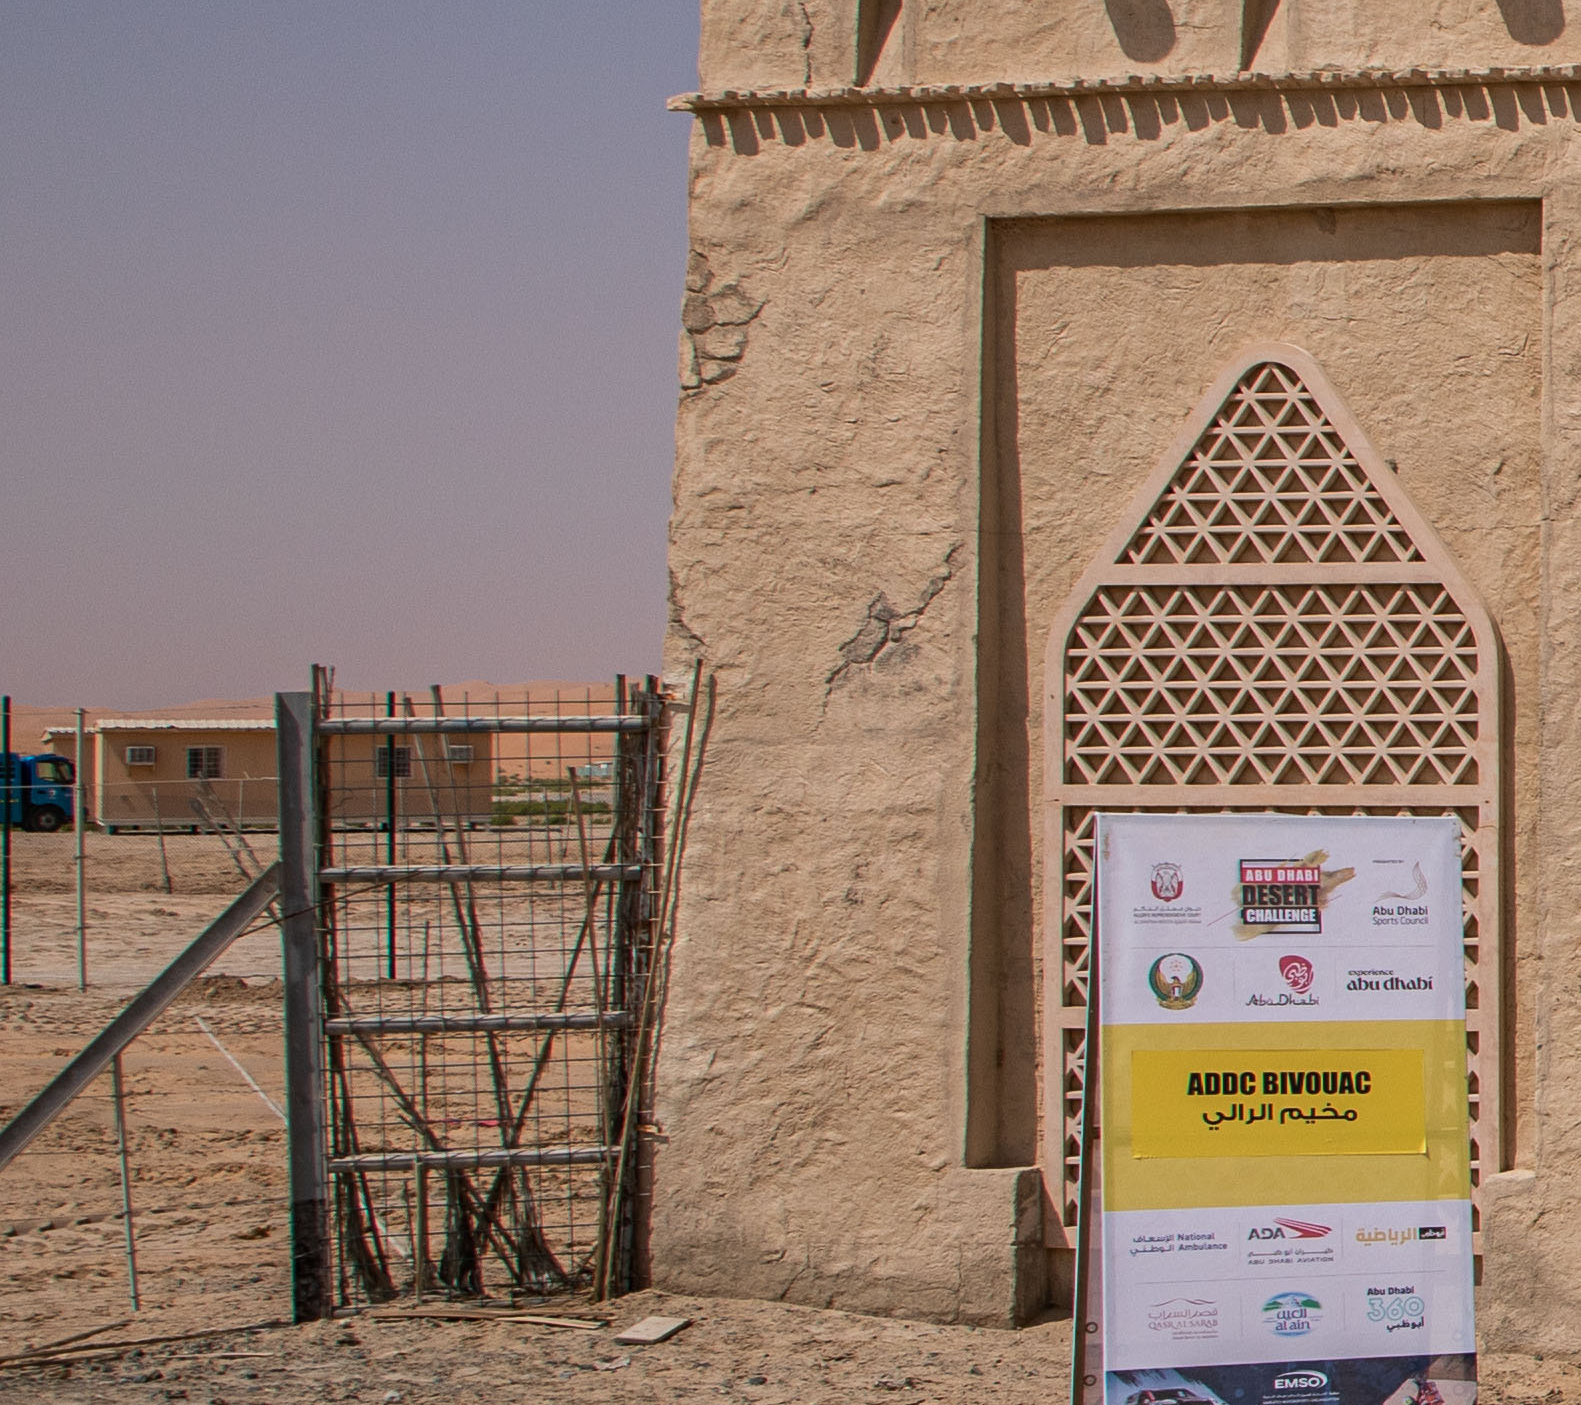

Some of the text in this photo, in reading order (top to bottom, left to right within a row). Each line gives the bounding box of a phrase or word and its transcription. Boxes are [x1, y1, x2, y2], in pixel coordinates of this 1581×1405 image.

[1245, 869, 1319, 882] ABU DHABI
[1242, 884, 1320, 906] DESERT
[1246, 908, 1317, 923] CHALLENGE
[1372, 905, 1428, 916] Abu Dhabi
[1372, 916, 1429, 926] Sports Council
[1346, 976, 1434, 991] abu dhabi
[1186, 1071, 1372, 1096] ADDC BIVOUAC
[1202, 1102, 1358, 1131] مخيم الرالي
[1177, 1232, 1216, 1242] National
[1248, 1227, 1286, 1241] ADA
[1356, 1226, 1417, 1246] الرياضية
[1178, 1242, 1228, 1252] Ambulance
[1367, 1285, 1415, 1296] Abu Dhabi
[1367, 1296, 1425, 1322] 360
[1273, 1377, 1320, 1389] EMSO
